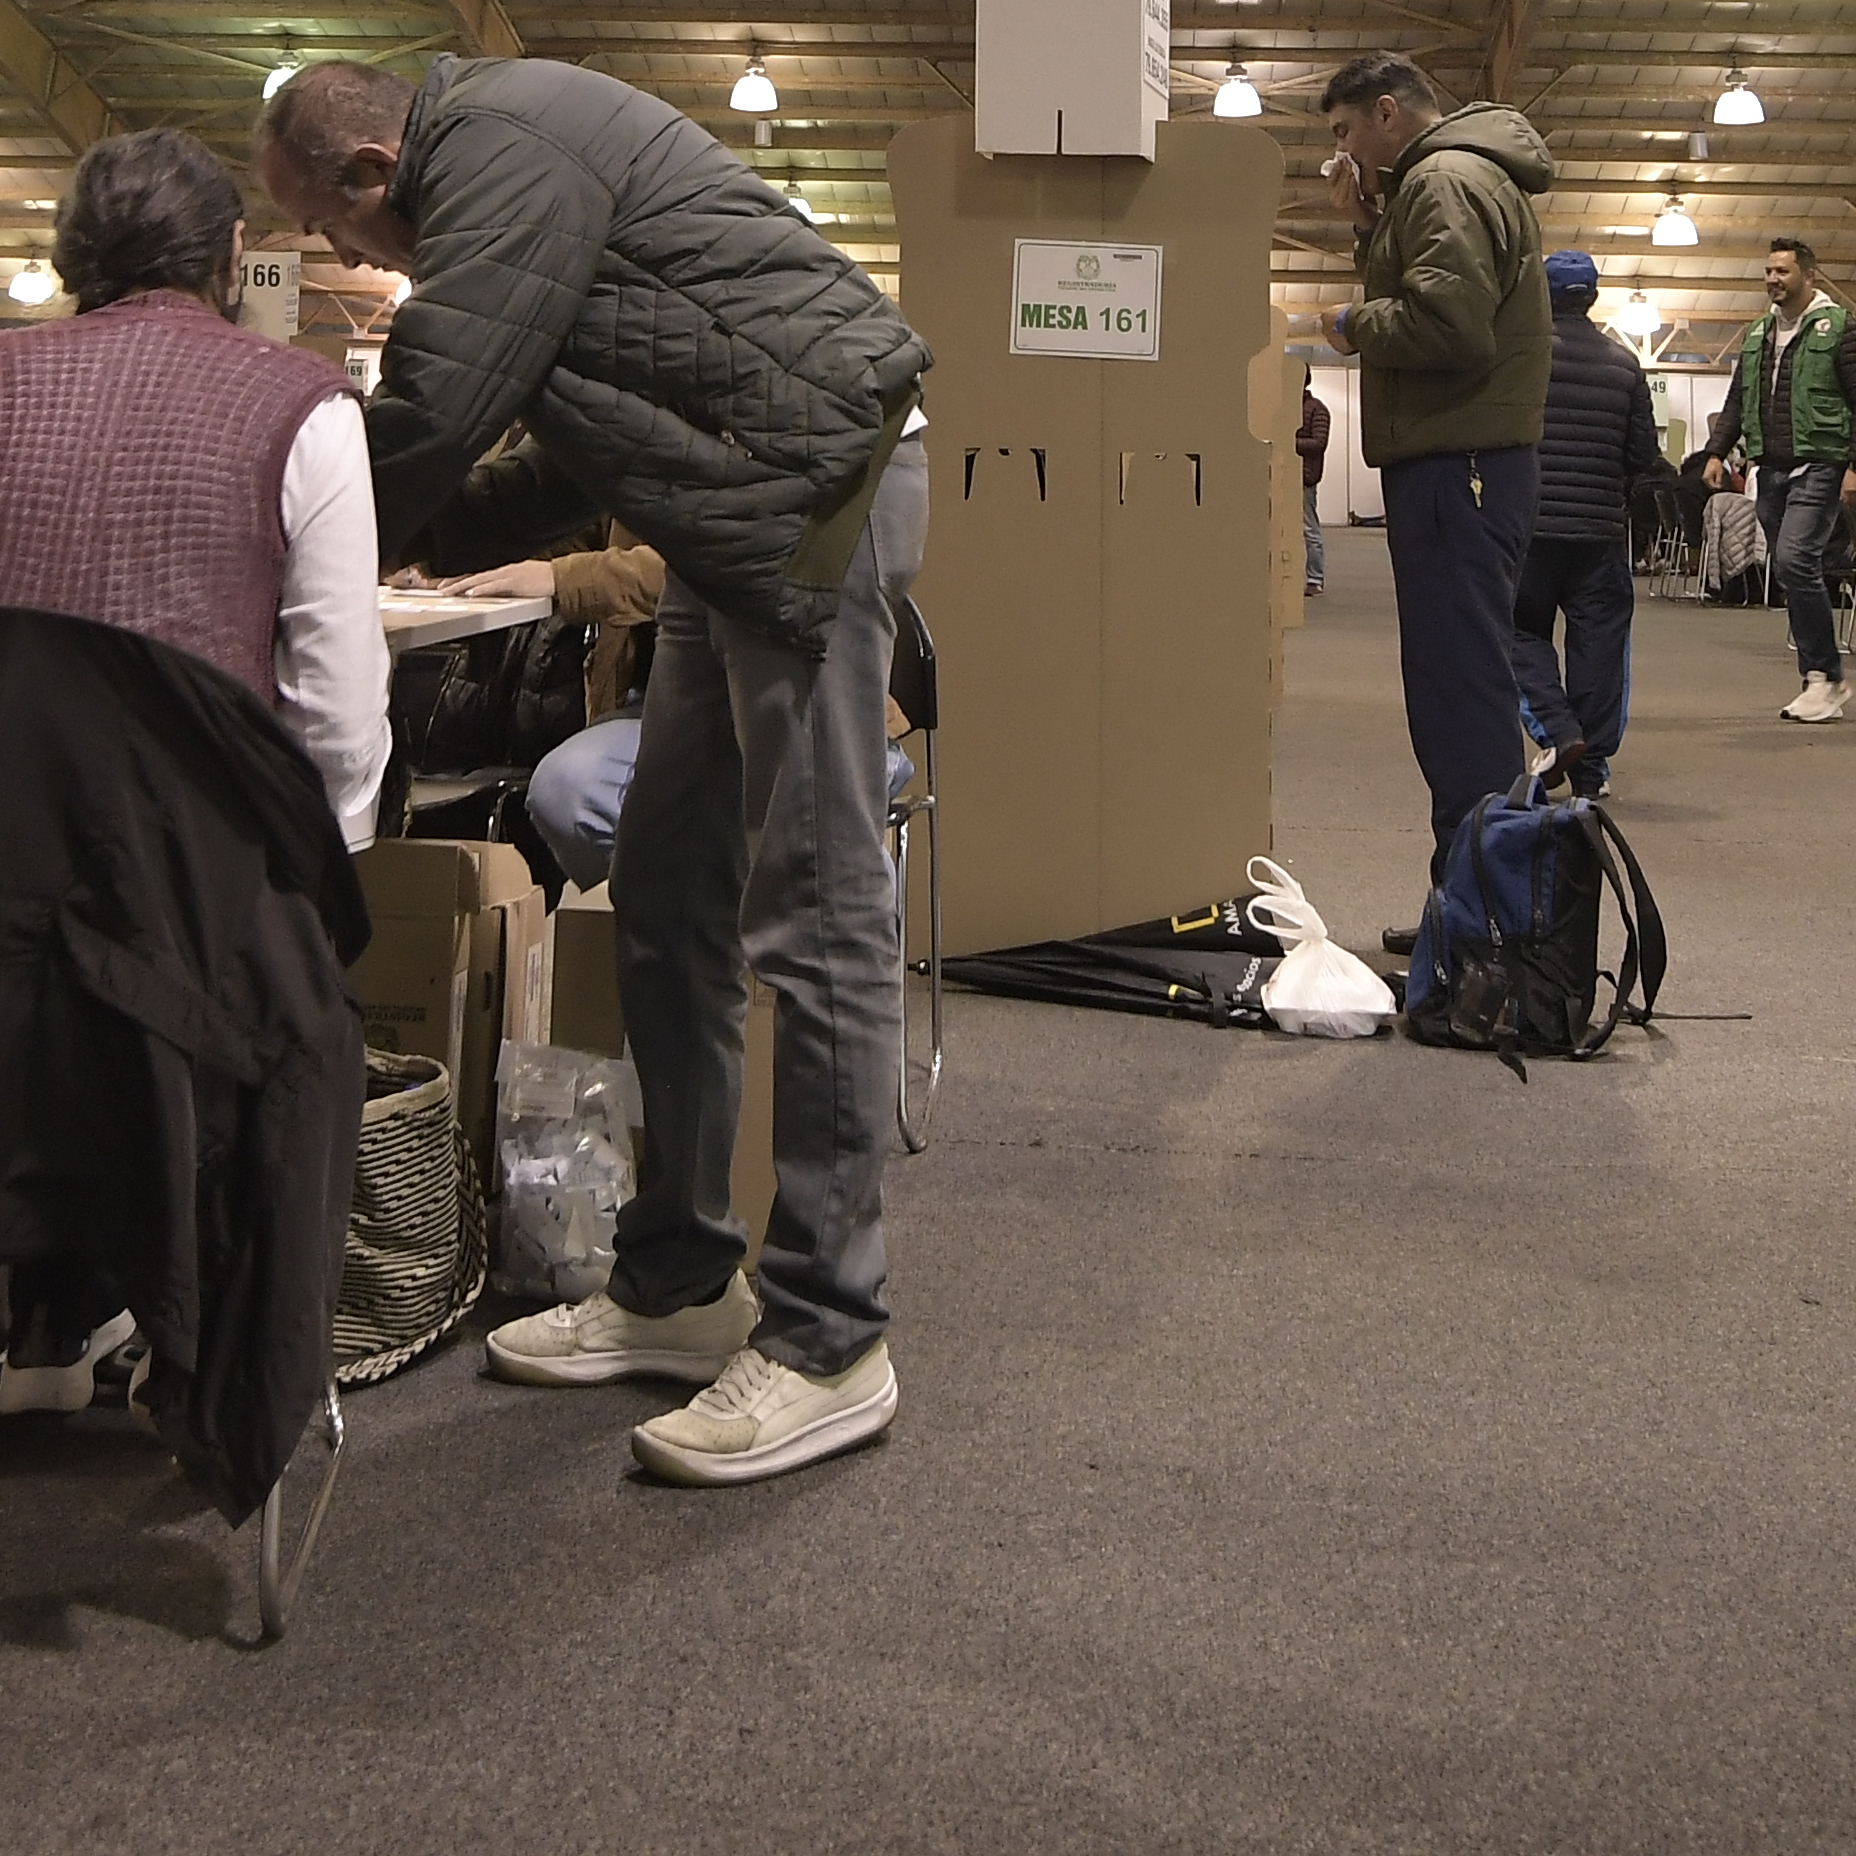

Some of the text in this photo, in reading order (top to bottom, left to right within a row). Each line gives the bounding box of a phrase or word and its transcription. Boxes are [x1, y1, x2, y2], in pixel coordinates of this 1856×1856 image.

[240, 263, 281, 288] 166
[1020, 303, 1148, 334] MESA 161
[1651, 380, 1667, 394] 49
